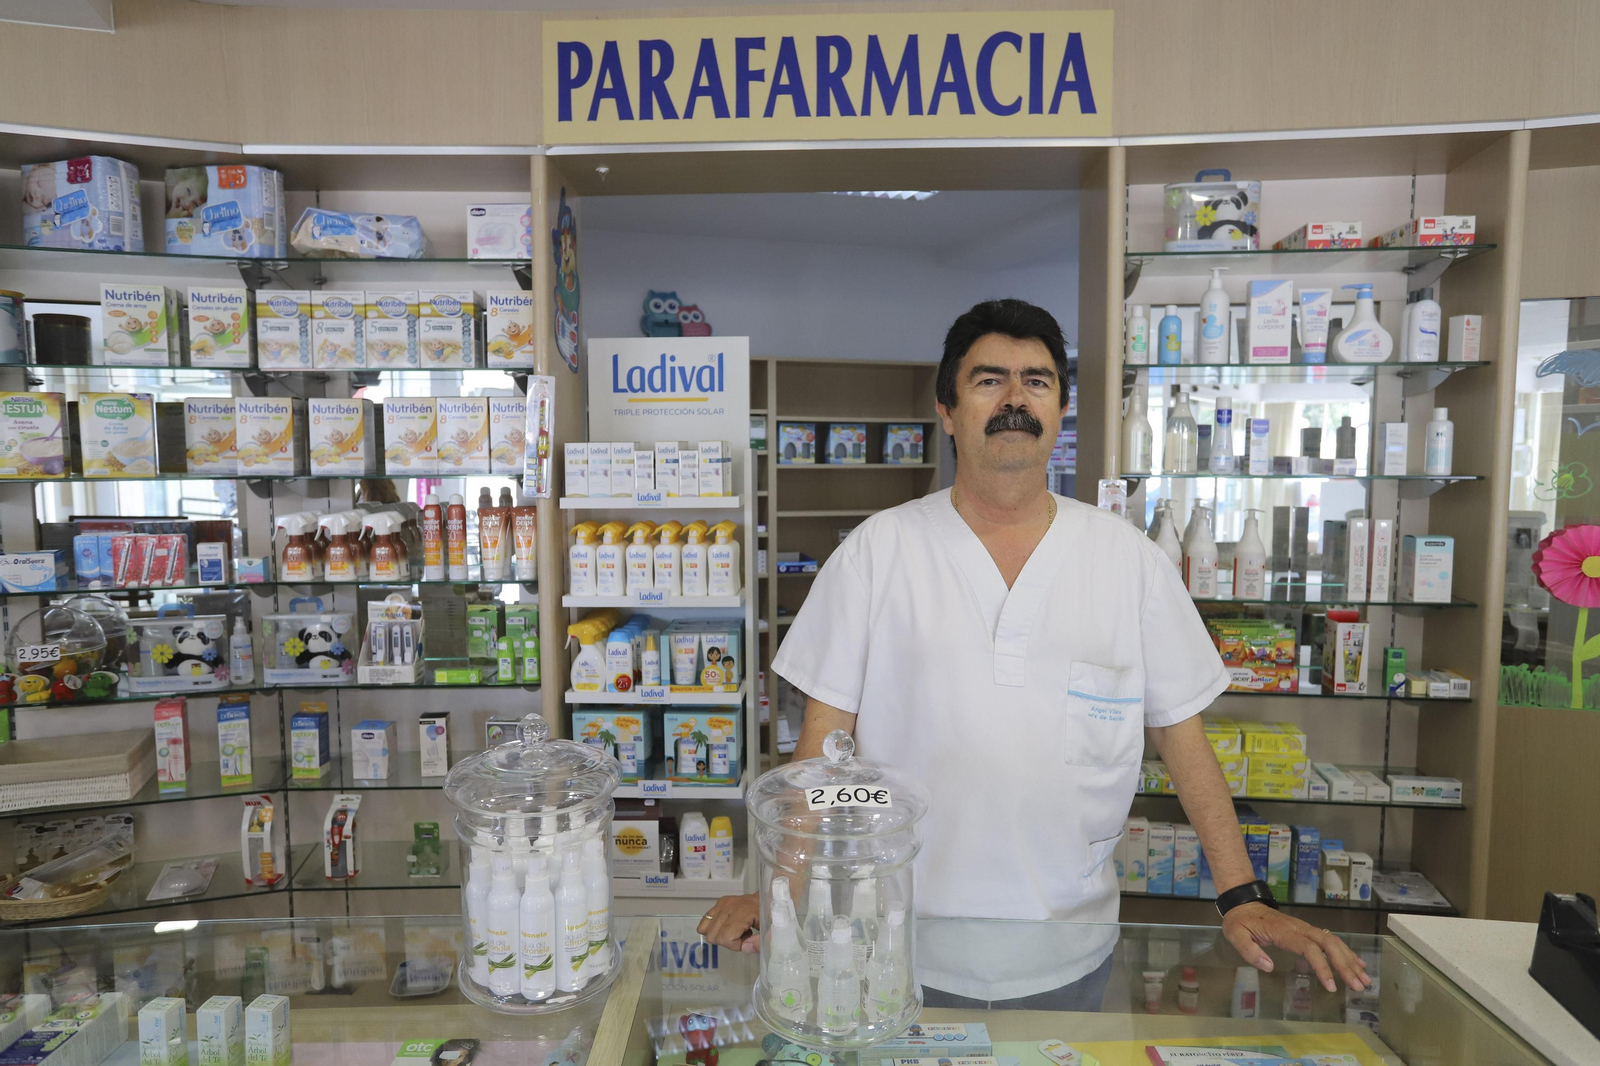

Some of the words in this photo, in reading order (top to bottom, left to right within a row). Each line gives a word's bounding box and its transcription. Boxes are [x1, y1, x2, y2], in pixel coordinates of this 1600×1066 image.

[557, 31, 1098, 122] PARAFARMACIA
[203, 206, 240, 221] Chelino
[105, 289, 160, 302] Nutribén
[191, 292, 242, 304] Nutribén
[267, 299, 298, 307] Nutribén
[322, 300, 353, 308] Nutribén
[375, 299, 406, 308] Nutribén
[429, 298, 461, 307] Nutribén
[490, 307, 498, 316] 8
[260, 320, 269, 333] 5
[315, 321, 324, 334] 8
[369, 321, 379, 334] 5
[423, 319, 433, 333] 5
[612, 352, 724, 393] Ladival
[96, 404, 133, 414] Nestum
[239, 403, 288, 414] Nutribén
[312, 404, 359, 414] Nutribén
[386, 403, 432, 413] Nutribén
[439, 403, 484, 413] Nutribén
[492, 403, 526, 413] Nutrib
[613, 408, 641, 416] TRIPLE
[642, 407, 694, 416] PROTECCIÓN
[189, 415, 197, 424] 8
[239, 415, 248, 424] 8
[313, 415, 321, 425] 8
[387, 415, 395, 424] 8
[440, 415, 447, 424] 8
[493, 415, 500, 424] 8
[637, 492, 661, 501] Ladival
[638, 592, 663, 601] Ladival
[674, 635, 695, 643] Ladival
[705, 635, 726, 643] Ladival
[18, 646, 60, 661] 2,95€
[607, 648, 627, 656] Ladival
[641, 689, 665, 698] Ladival
[643, 783, 667, 792] Ladival
[811, 787, 888, 806] 2,60€
[645, 875, 669, 884] Ladival
[564, 936, 588, 947] citrone
[522, 946, 550, 954] tronela
[661, 930, 719, 969] ival
[248, 1046, 267, 1055] Árbol
[406, 1041, 433, 1052] otc
[142, 1048, 161, 1058] Árbol
[201, 1047, 220, 1056] Árbol
[142, 1057, 153, 1066] del
[154, 1058, 162, 1066] Té
[200, 1055, 211, 1063] del
[212, 1055, 221, 1063] Té
[248, 1054, 258, 1062] del
[260, 1054, 268, 1062] Té
